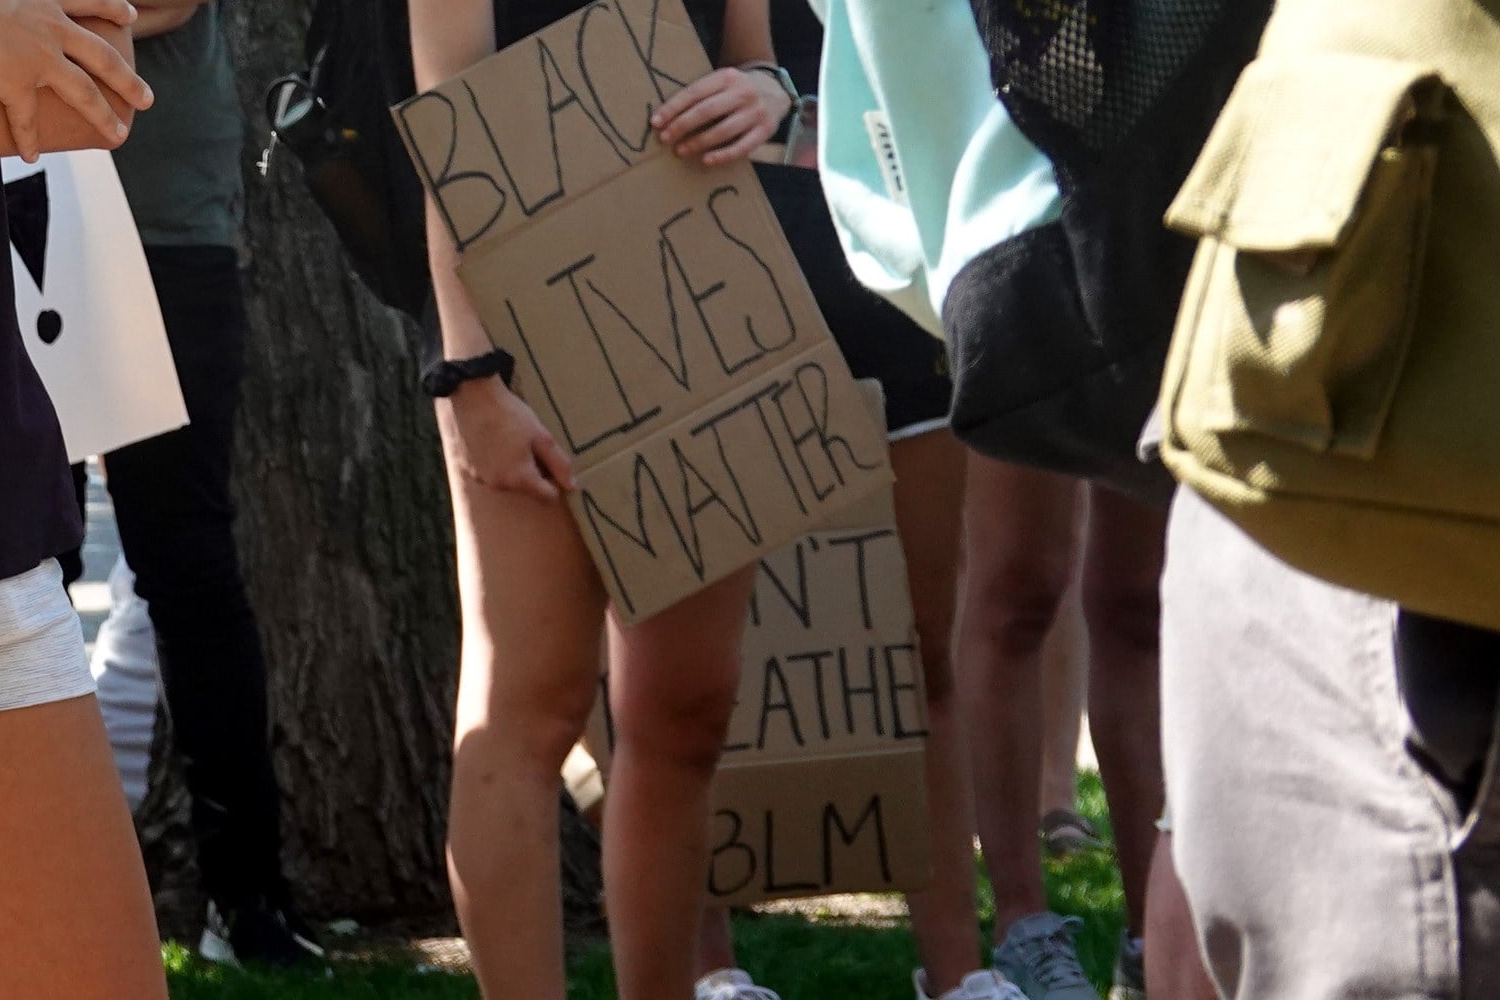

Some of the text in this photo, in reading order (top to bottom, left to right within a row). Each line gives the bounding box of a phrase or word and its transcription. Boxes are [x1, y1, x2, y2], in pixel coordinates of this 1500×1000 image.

[503, 184, 797, 455] LIVES
[580, 361, 884, 614] MATTER
[723, 643, 930, 751] ATHE
[706, 793, 893, 897] BLM
